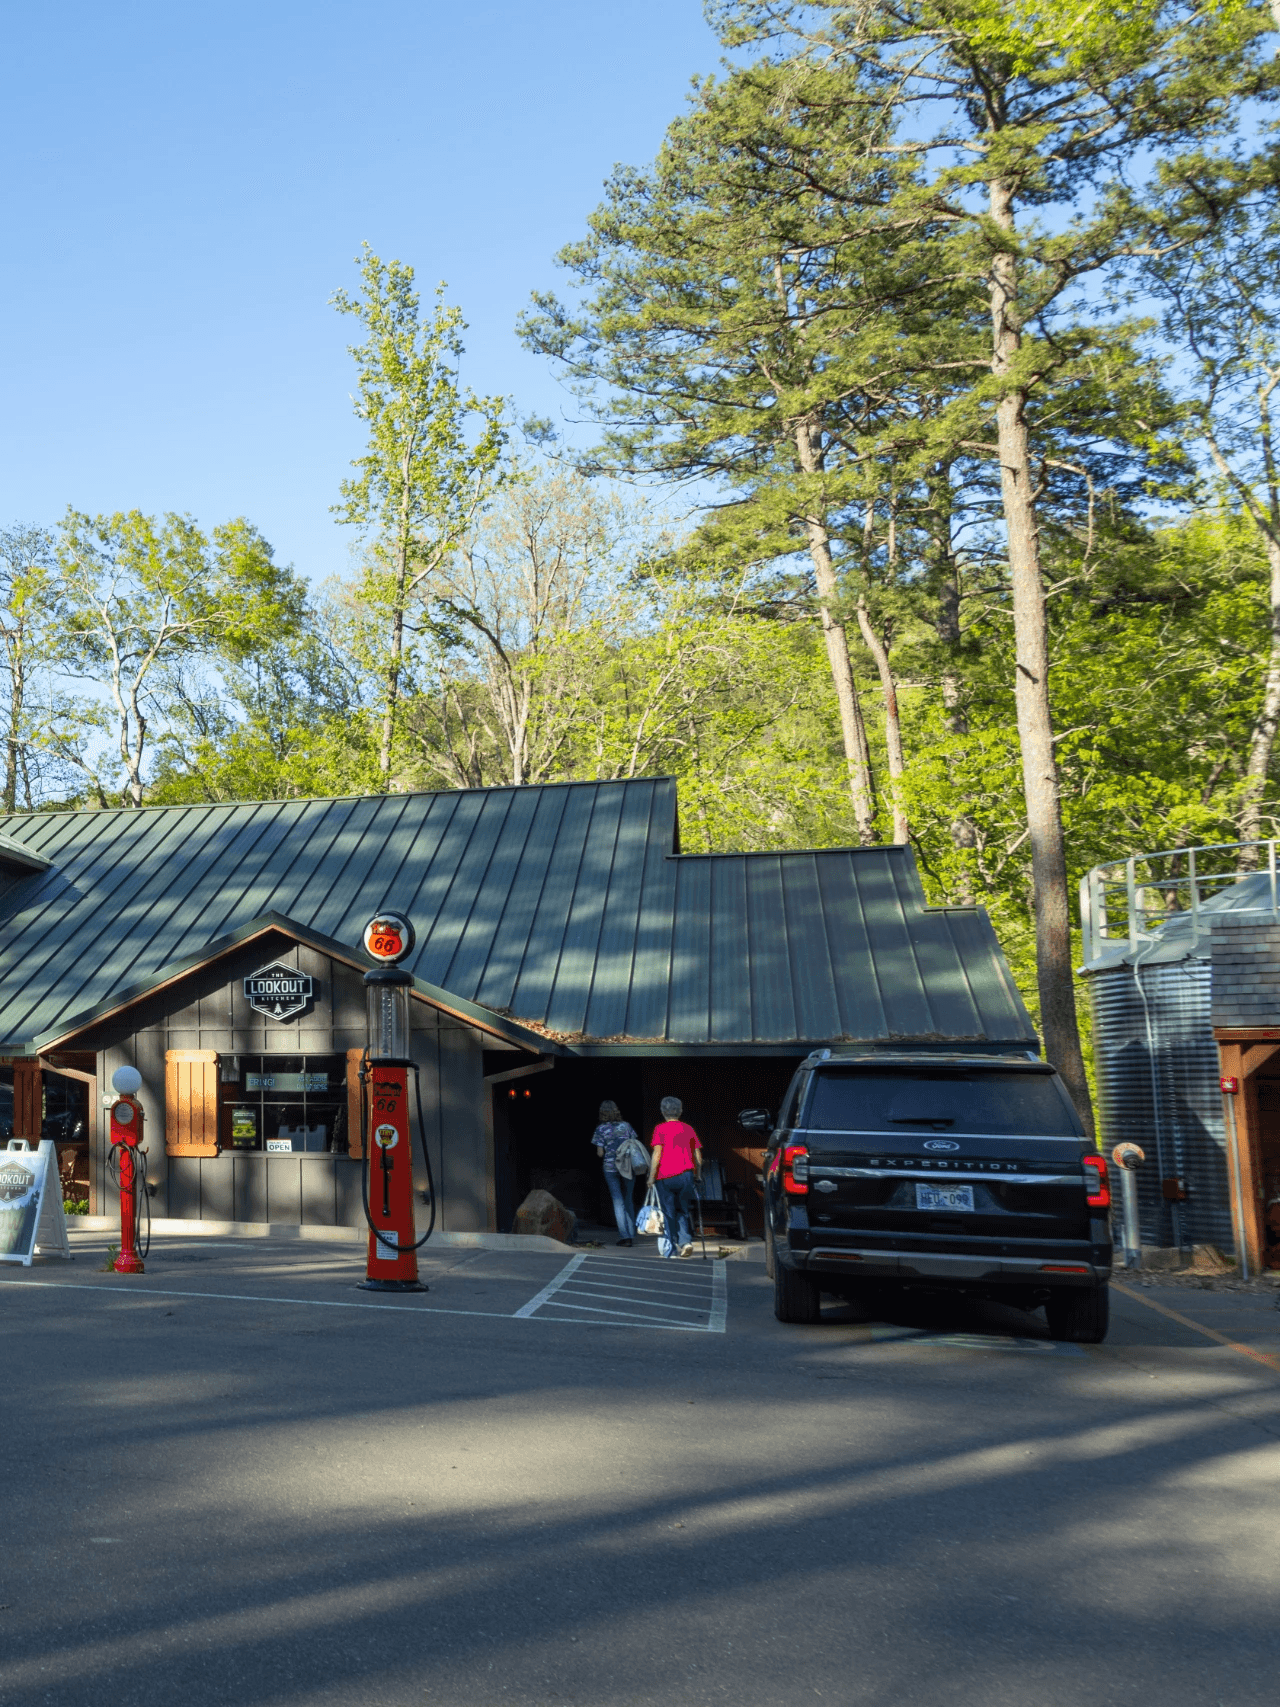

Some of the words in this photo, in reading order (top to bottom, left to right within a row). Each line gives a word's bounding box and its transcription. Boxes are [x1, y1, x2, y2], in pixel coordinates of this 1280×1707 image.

[375, 937, 395, 952] 66
[251, 980, 304, 994] LOOKOUT
[377, 1098, 397, 1112] 66
[870, 1159, 1018, 1171] EXPEDITION
